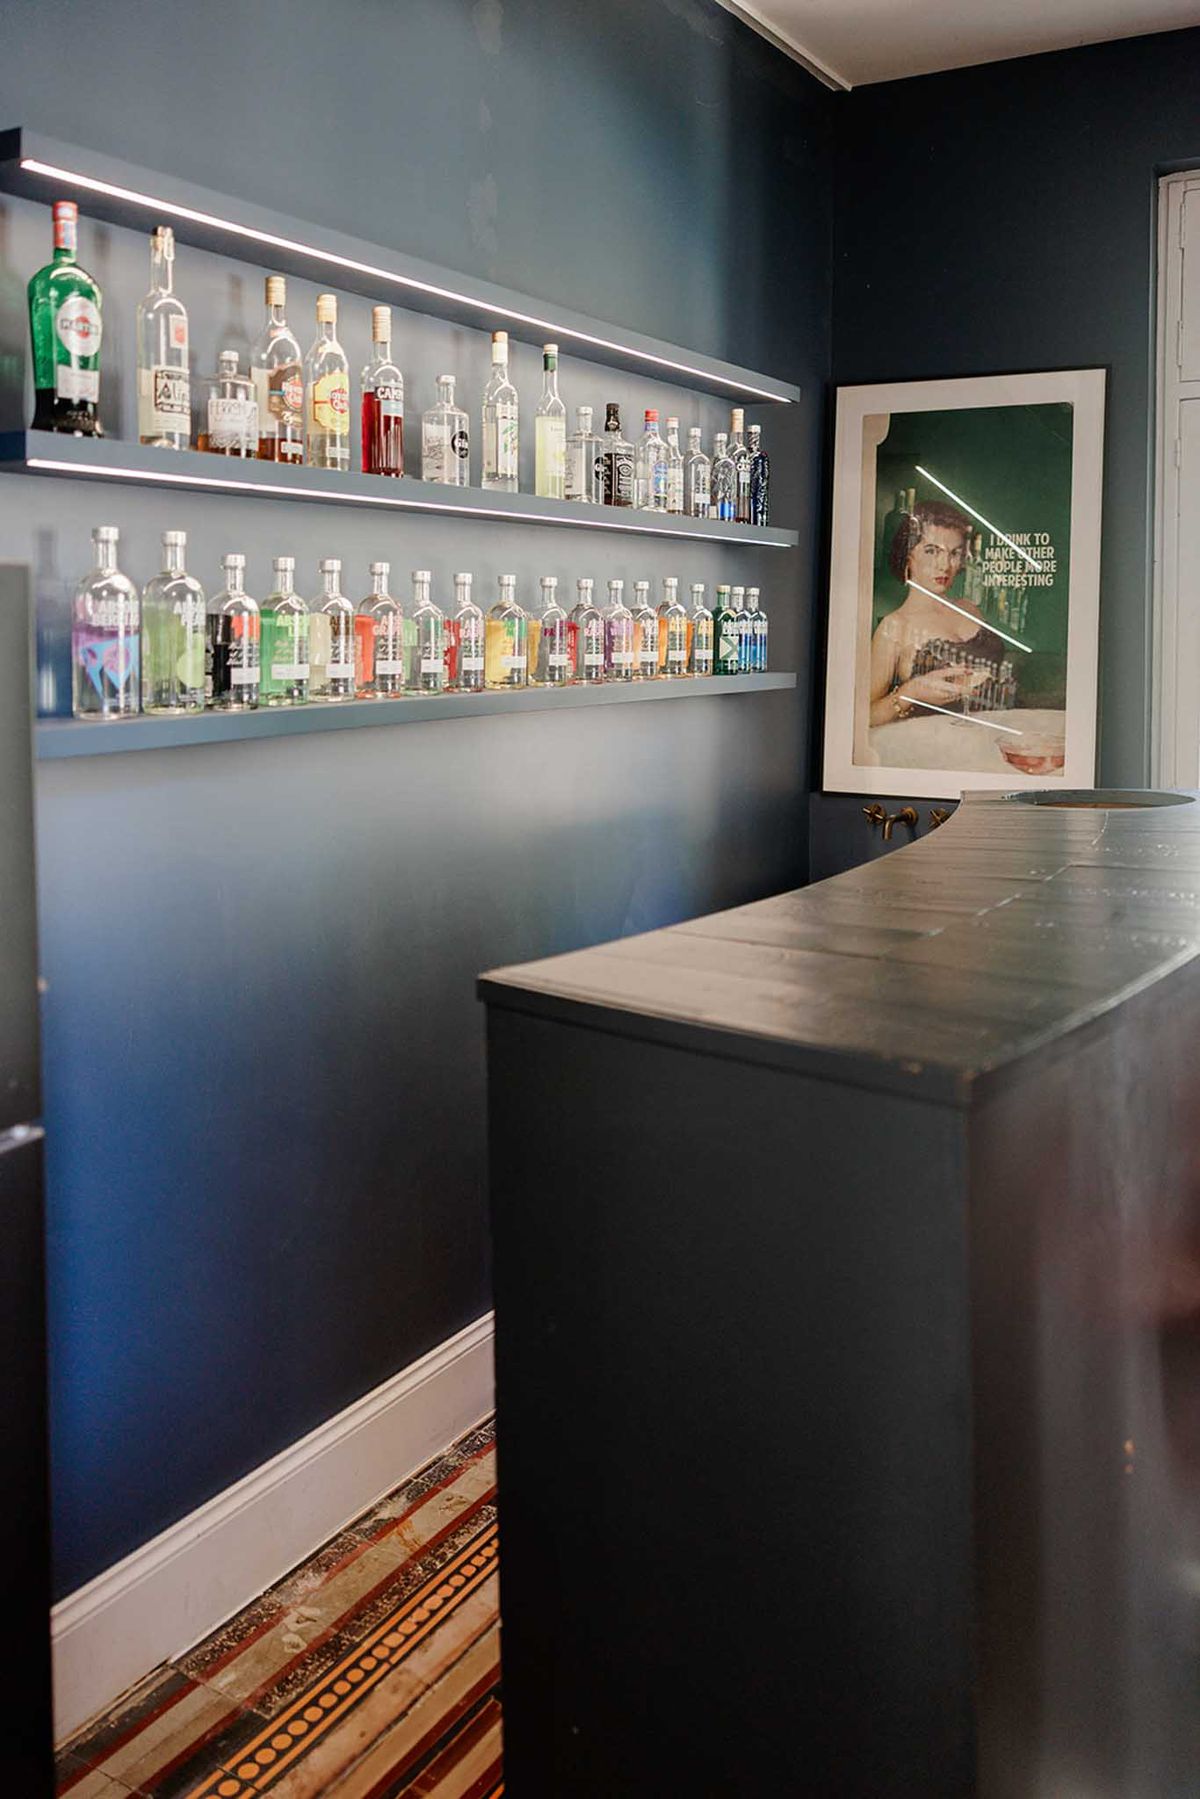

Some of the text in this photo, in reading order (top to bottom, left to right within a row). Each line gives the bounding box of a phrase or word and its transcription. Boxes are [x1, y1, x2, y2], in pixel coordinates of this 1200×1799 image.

[990, 533, 995, 546] I
[1034, 532, 1050, 545] TO
[985, 546, 1055, 559] MAKE OTHER
[982, 560, 1057, 573] PEOPLE MORE
[983, 574, 1054, 587] INTERESTING
